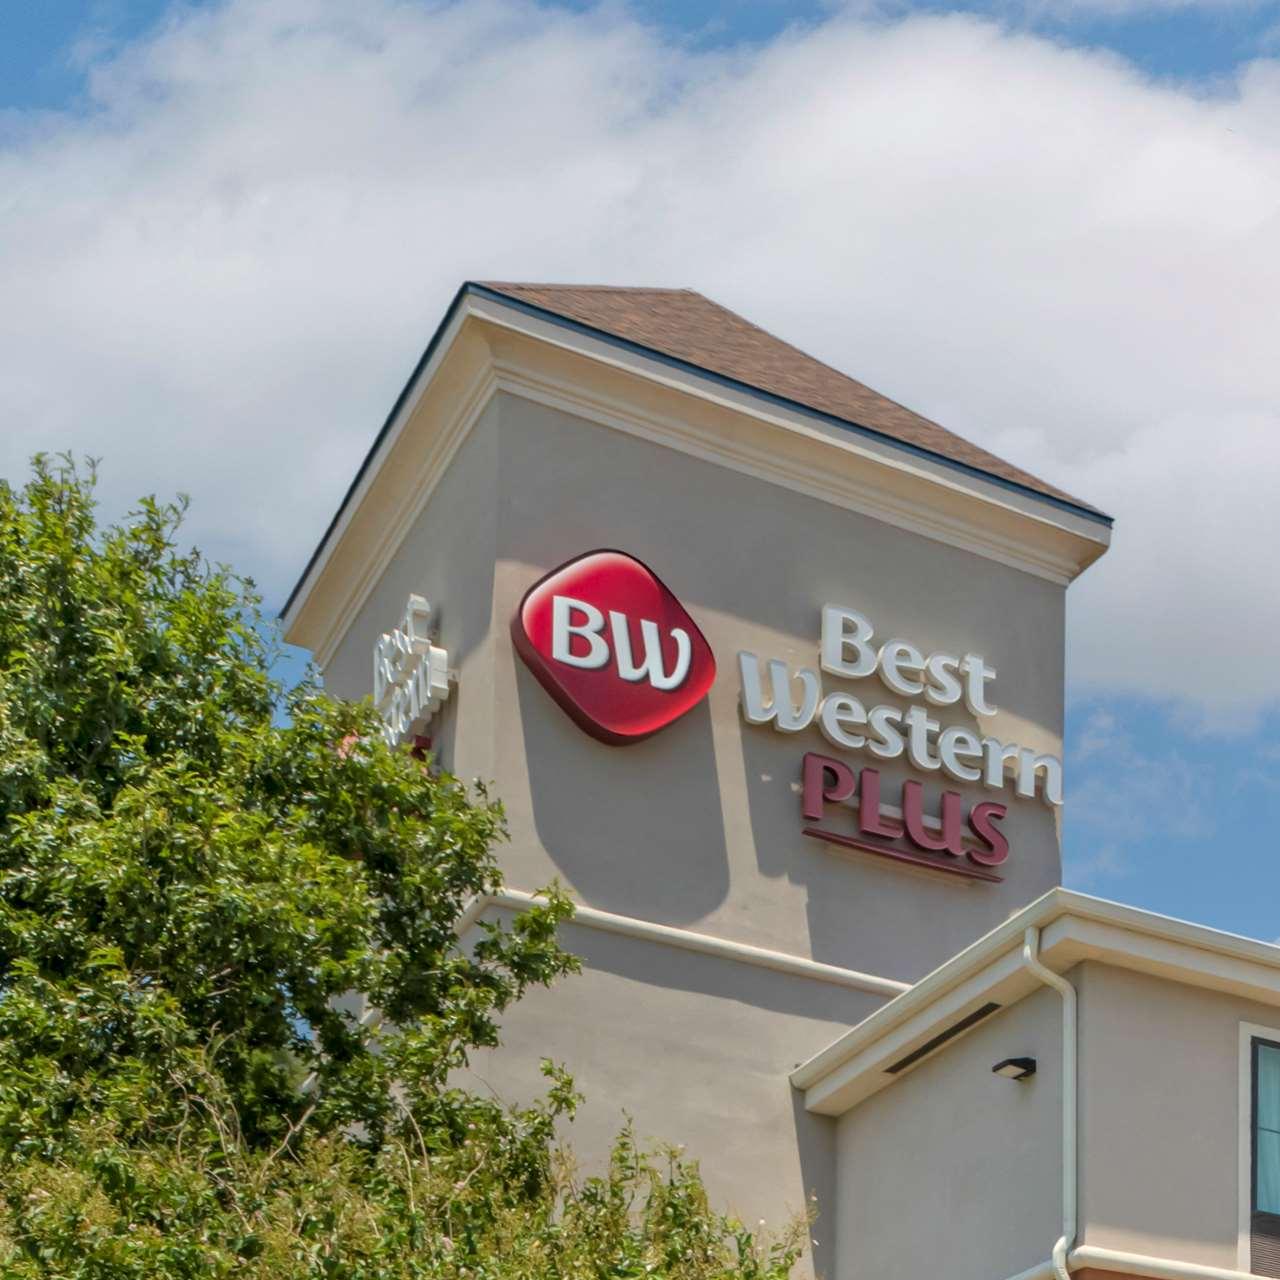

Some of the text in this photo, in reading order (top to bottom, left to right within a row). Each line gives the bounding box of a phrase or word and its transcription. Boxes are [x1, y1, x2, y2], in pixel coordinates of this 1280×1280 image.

[552, 595, 692, 691] BW
[820, 604, 999, 717] Best
[737, 651, 1064, 805] Western
[801, 752, 1010, 866] PLUS
